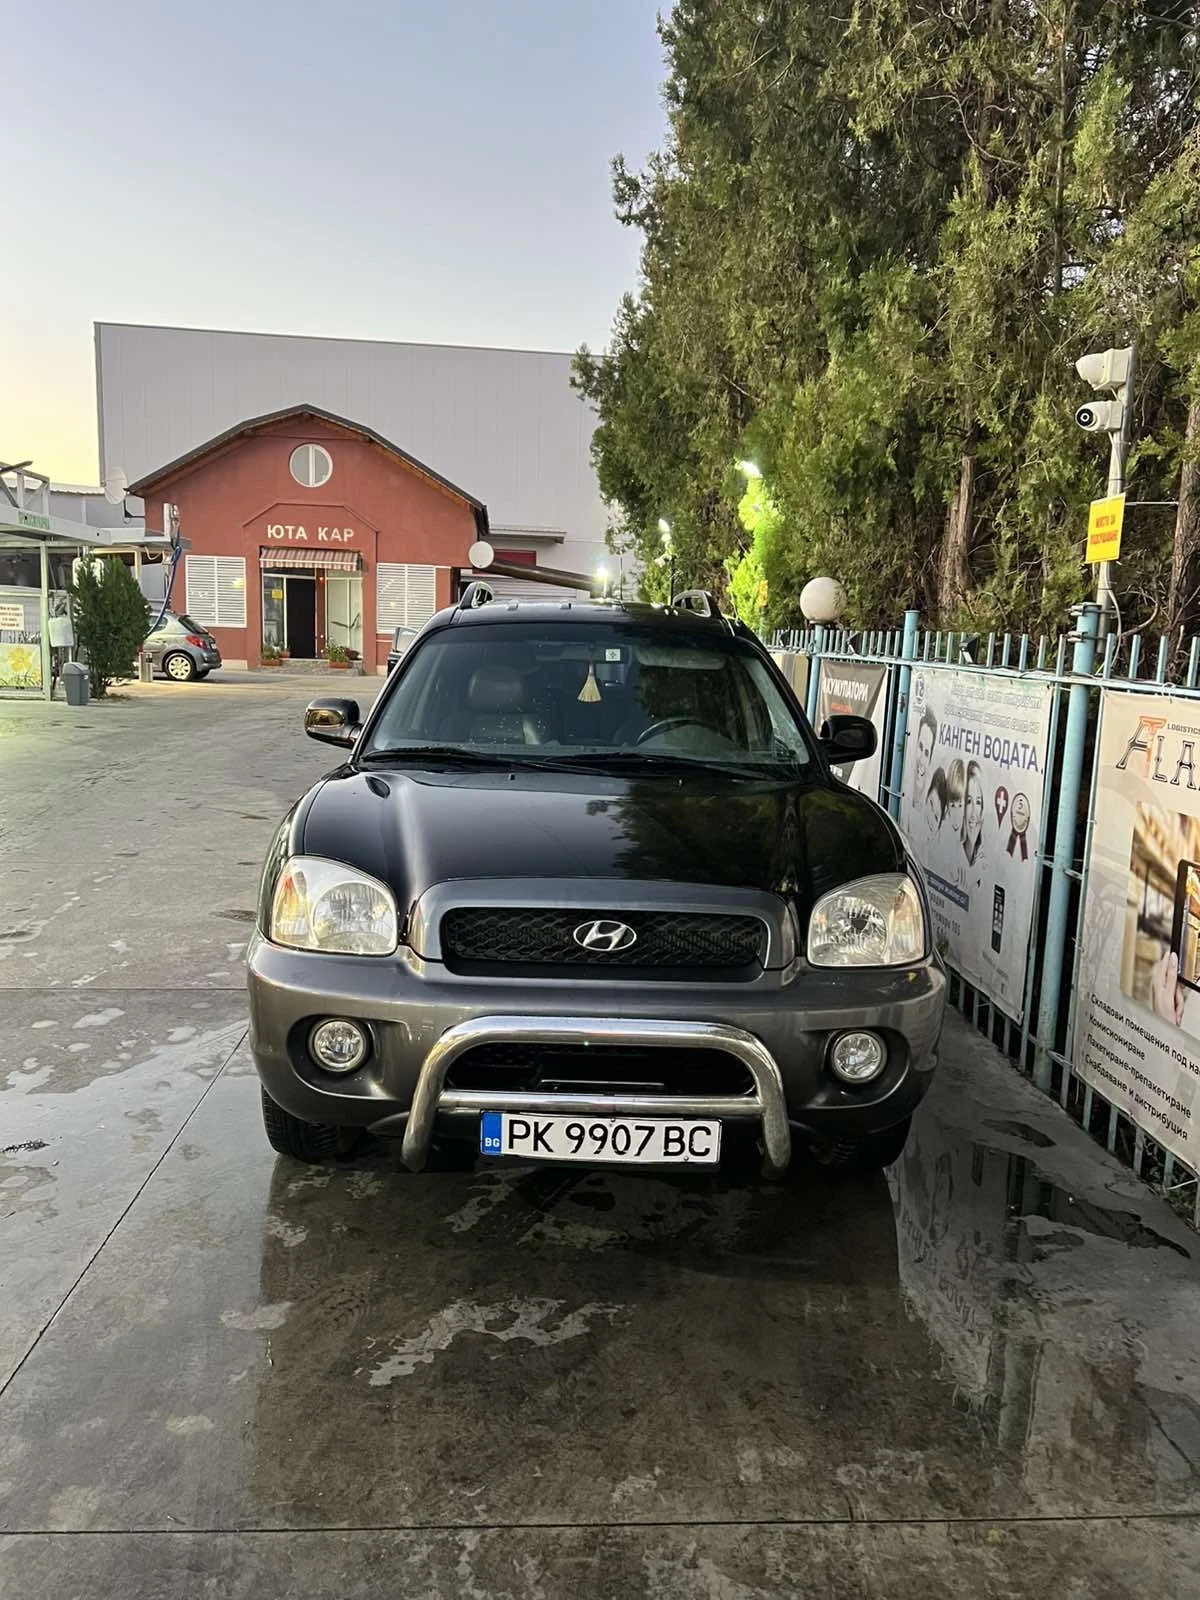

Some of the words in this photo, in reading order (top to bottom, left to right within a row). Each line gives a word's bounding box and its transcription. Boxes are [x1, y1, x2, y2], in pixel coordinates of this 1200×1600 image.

[267, 524, 308, 540] ЮТА
[318, 526, 354, 542] КАР
[938, 722, 981, 756] КАНГЕН
[983, 734, 1039, 772] ВОДАТА
[1088, 1014, 1146, 1061] Комисиониране
[1090, 993, 1124, 1024] Складови
[1125, 1017, 1170, 1055] помещения
[1171, 1049, 1187, 1069] под
[1189, 1061, 1200, 1076] на
[1085, 1053, 1128, 1092] Снабдяване
[1128, 1086, 1135, 1097] и
[1134, 1092, 1188, 1141] дистрибуция
[1086, 1033, 1192, 1119] Пакетиране-препакетиране
[485, 1137, 500, 1148] BG
[508, 1119, 554, 1153] PK
[565, 1122, 656, 1157] 9907
[663, 1126, 712, 1157] BC
